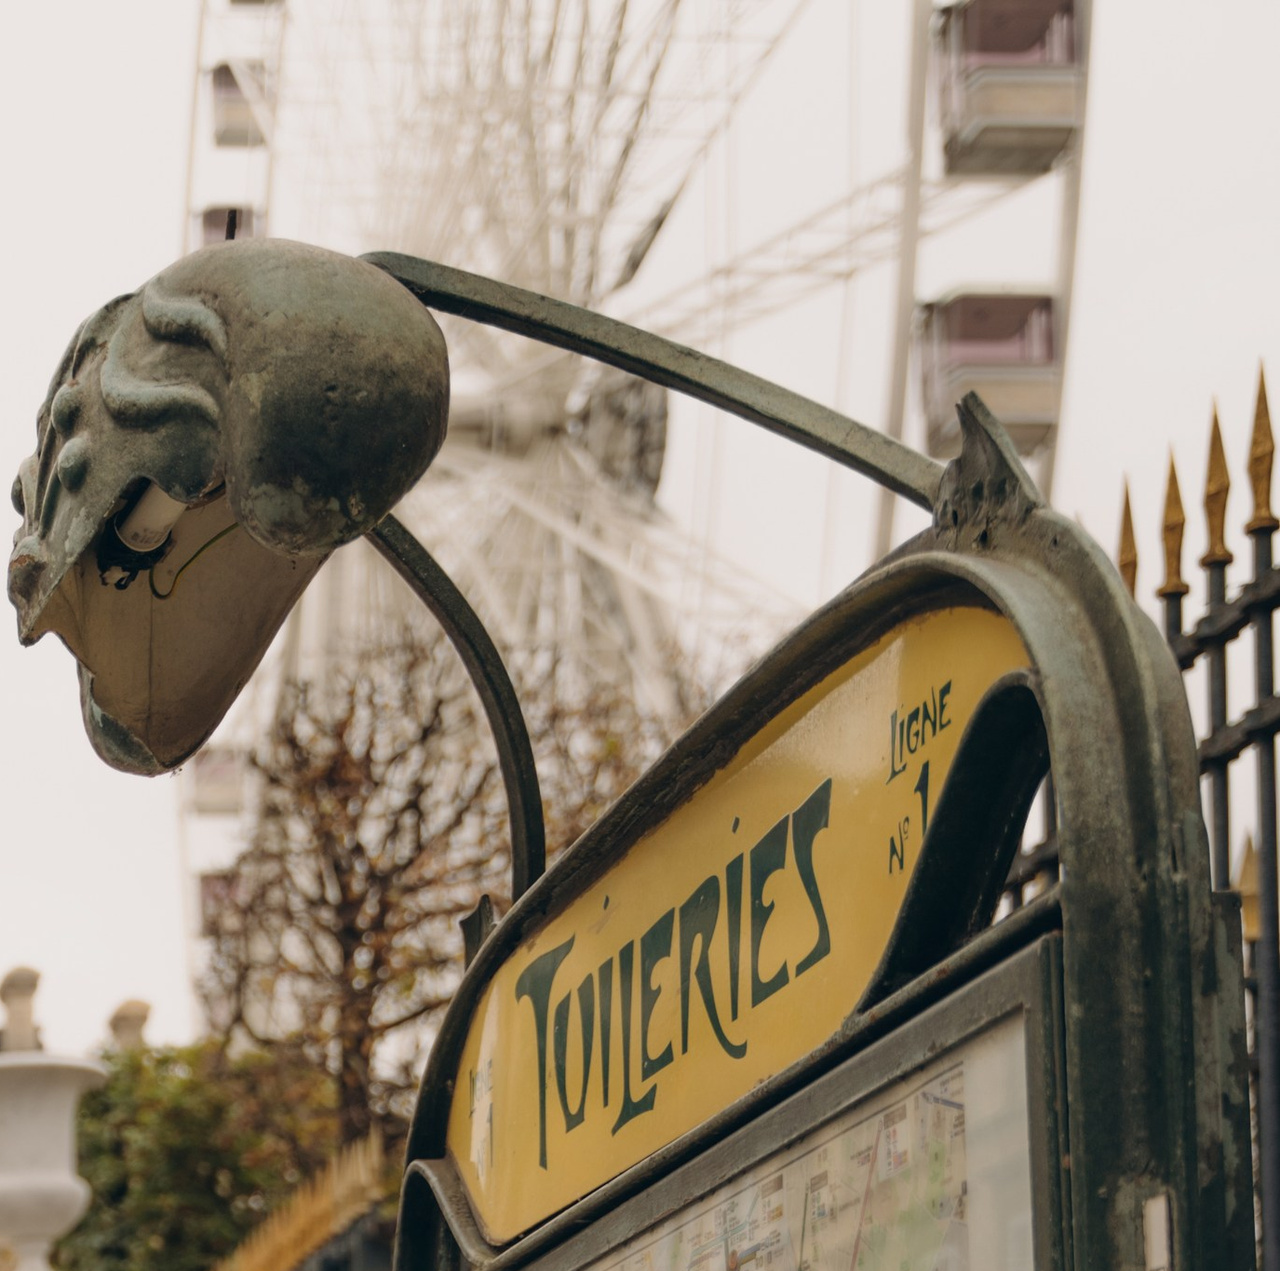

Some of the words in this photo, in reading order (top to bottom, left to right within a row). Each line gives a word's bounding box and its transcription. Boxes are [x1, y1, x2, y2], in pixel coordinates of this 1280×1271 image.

[886, 679, 952, 785] LIGNE
[914, 760, 930, 838] 1
[515, 777, 833, 1170] TUILERIES
